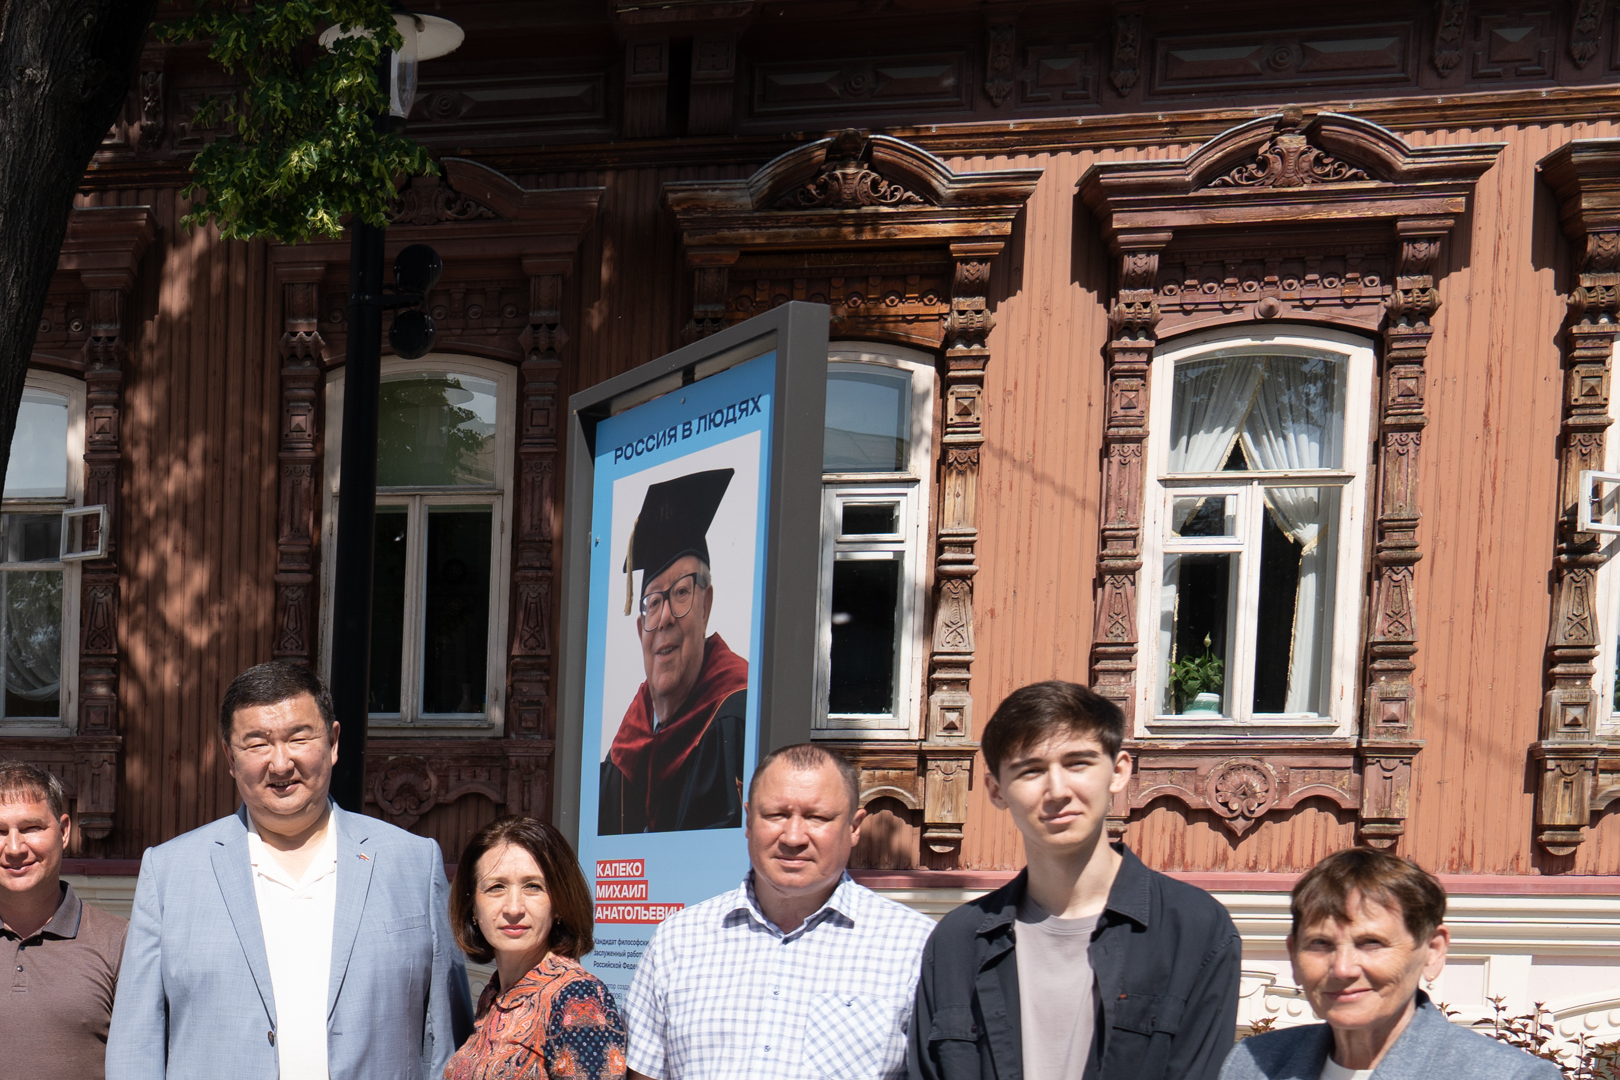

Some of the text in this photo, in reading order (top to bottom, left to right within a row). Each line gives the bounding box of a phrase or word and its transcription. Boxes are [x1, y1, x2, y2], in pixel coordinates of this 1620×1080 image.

[614, 394, 762, 465] РОССИЯ В ЛЮДЯХ
[596, 862, 642, 877] КАПЕКО
[596, 884, 645, 898] МИХАИЛ
[594, 937, 650, 947] Кандидат философски
[593, 949, 643, 959] заслуженный работ
[593, 960, 622, 969] Российской
